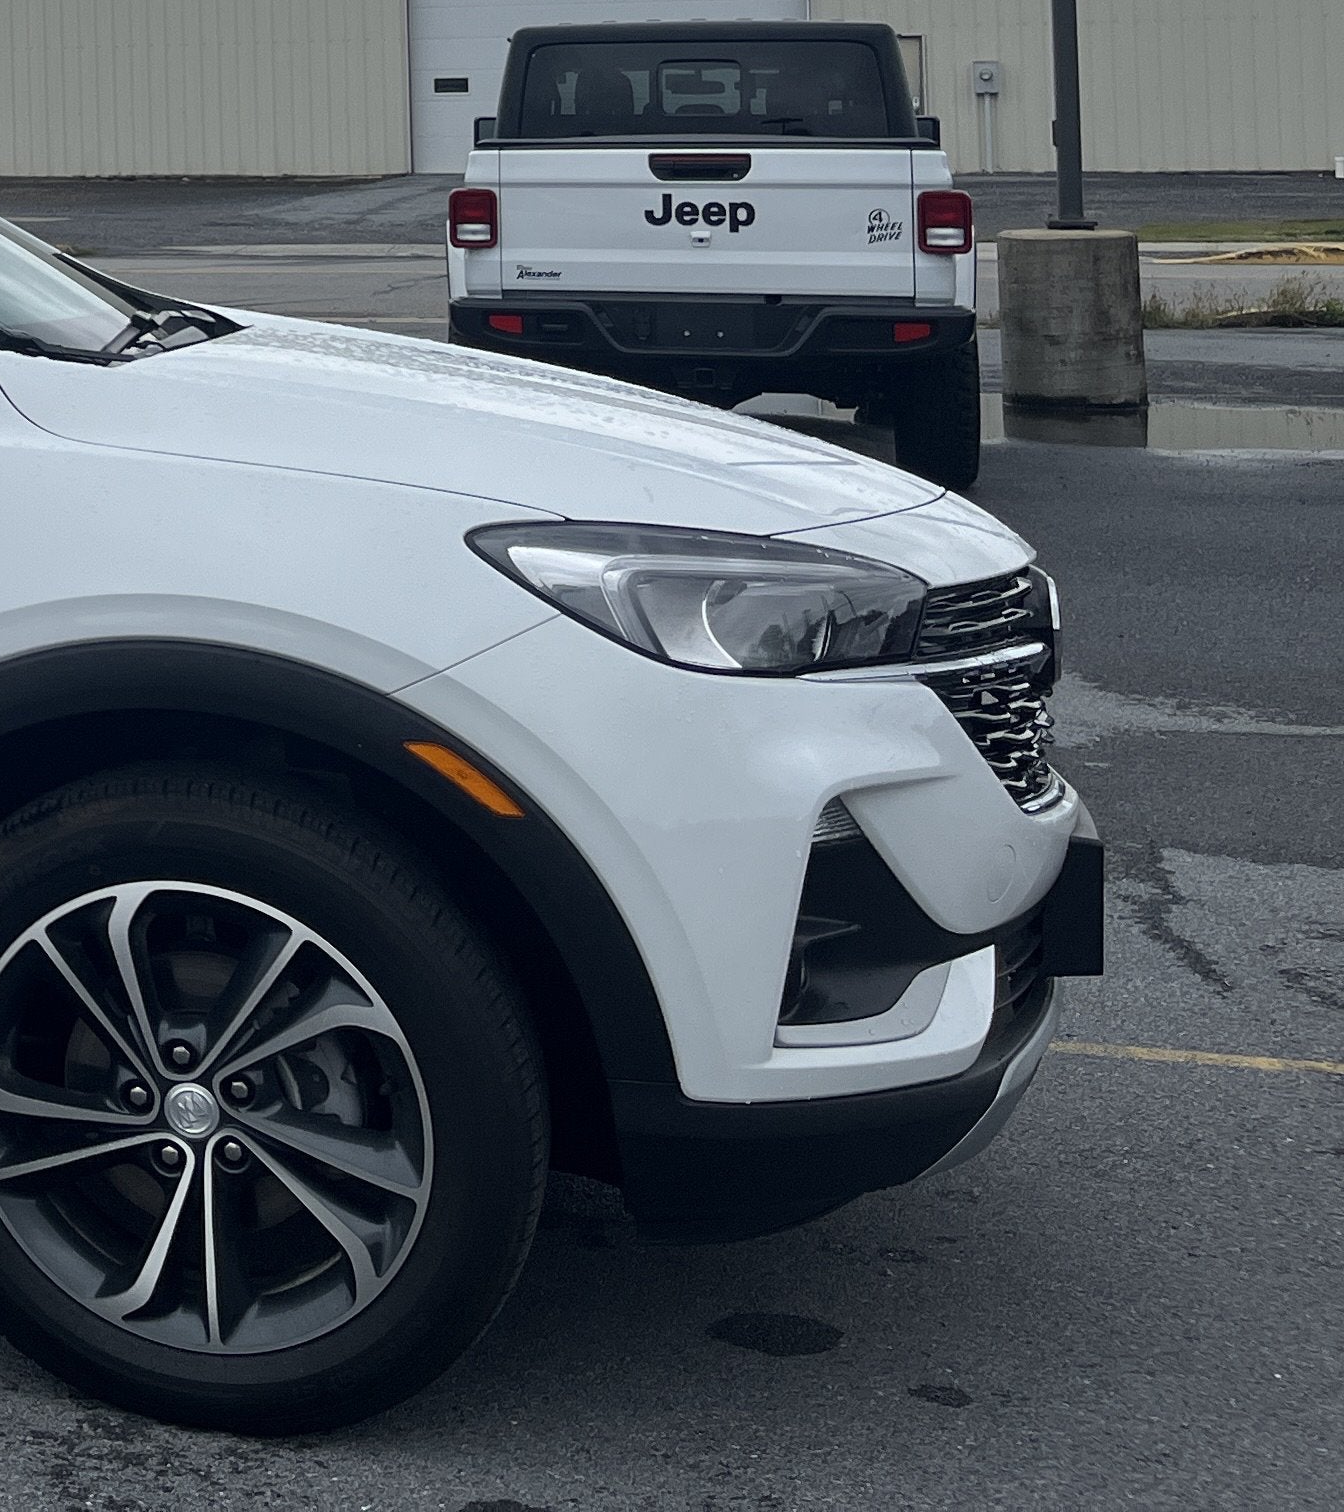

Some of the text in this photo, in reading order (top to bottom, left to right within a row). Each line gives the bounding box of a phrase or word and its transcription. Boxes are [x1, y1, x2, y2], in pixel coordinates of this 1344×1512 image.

[644, 193, 756, 233] Jeep
[867, 221, 903, 234] WHEEL
[868, 231, 902, 244] DRIVE
[516, 270, 562, 279] Alexander
